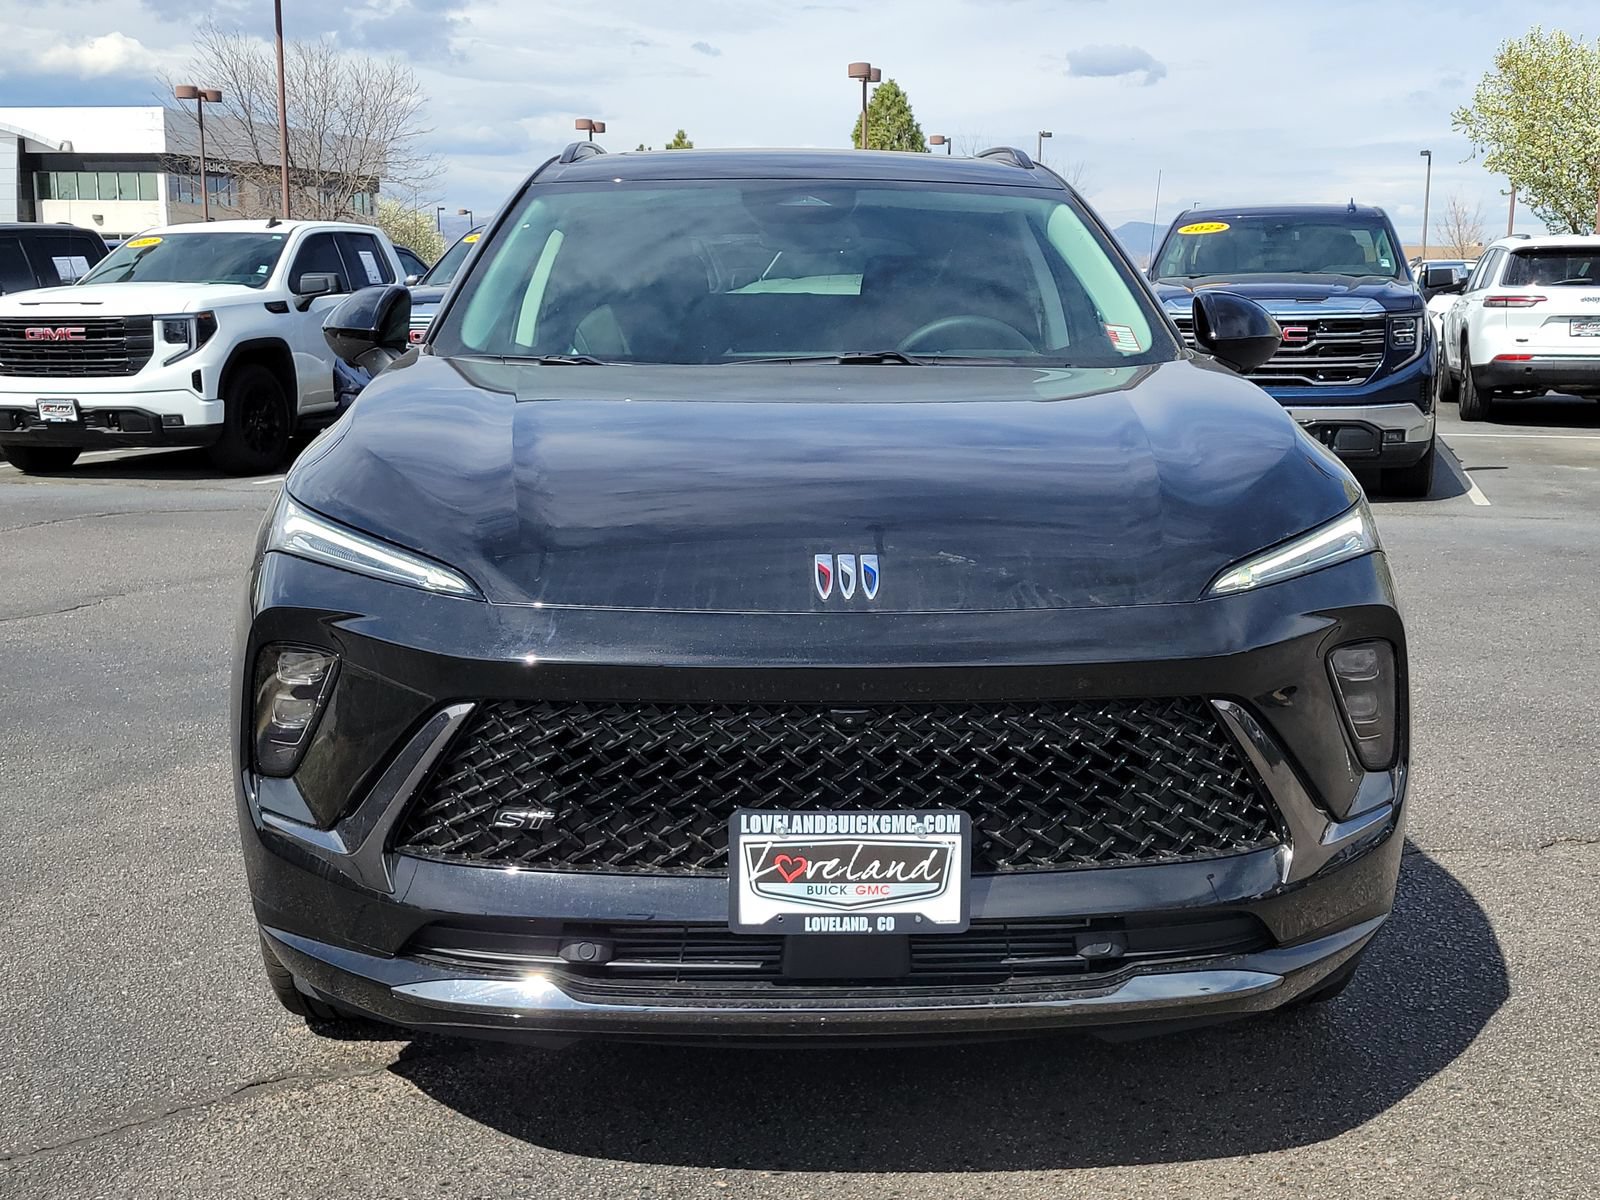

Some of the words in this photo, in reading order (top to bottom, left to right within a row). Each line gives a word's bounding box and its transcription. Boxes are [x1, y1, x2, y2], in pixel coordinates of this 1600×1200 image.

[25, 327, 86, 341] GMC
[494, 811, 555, 830] ST
[806, 885, 847, 895] BUICK
[855, 885, 890, 895] GMC
[804, 916, 873, 933] LOVELAND,
[877, 916, 896, 931] CO
